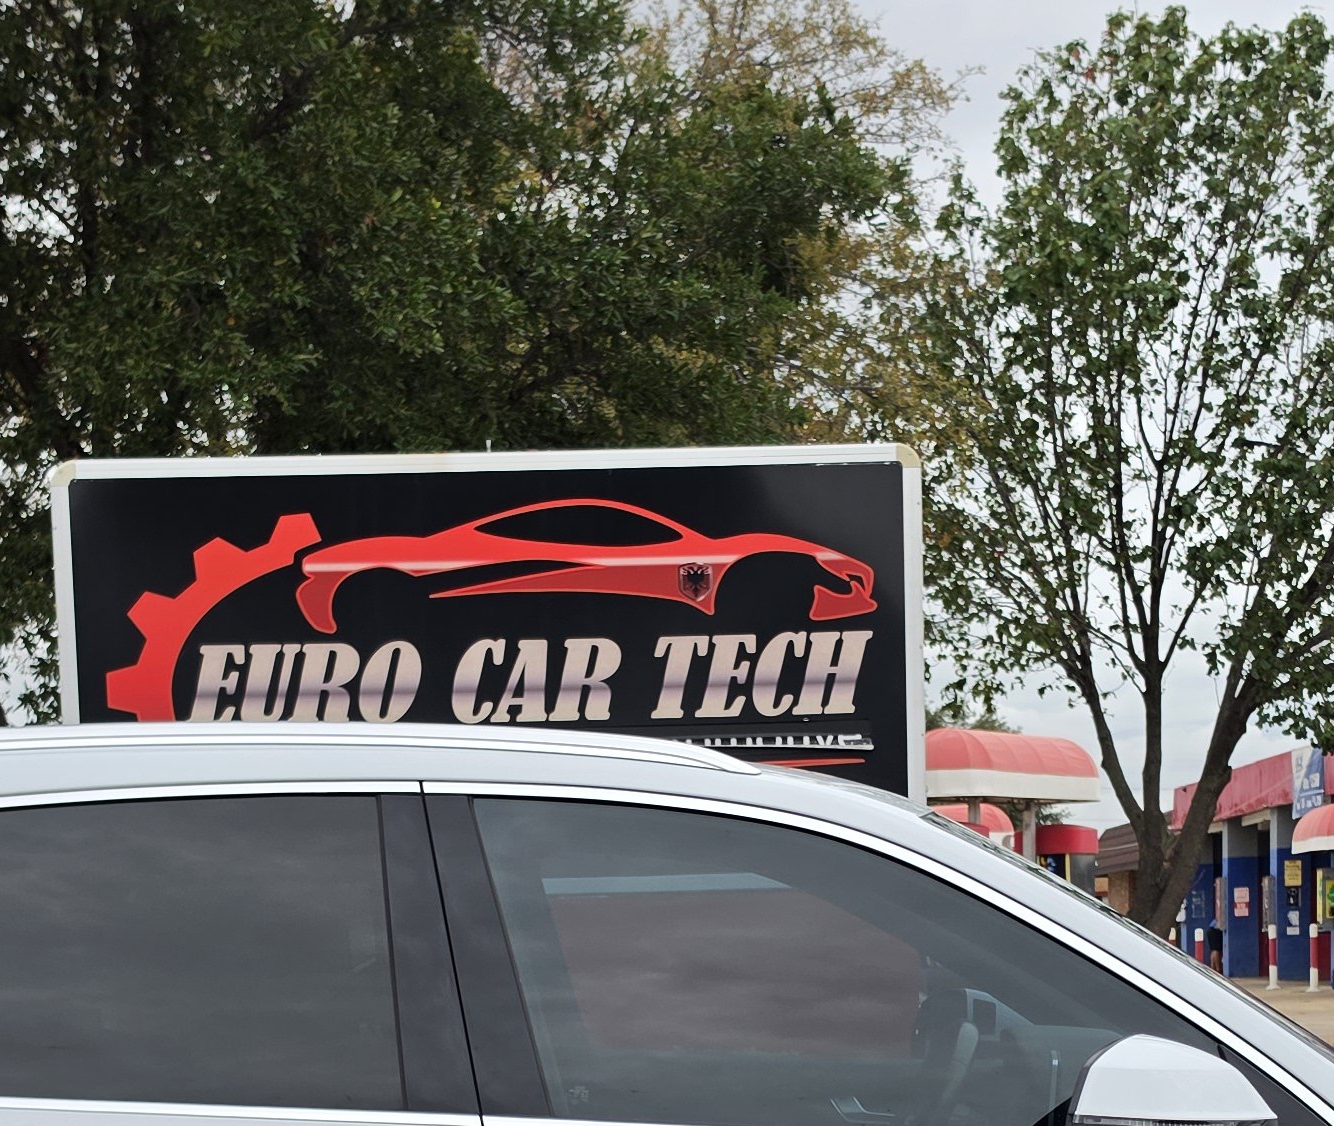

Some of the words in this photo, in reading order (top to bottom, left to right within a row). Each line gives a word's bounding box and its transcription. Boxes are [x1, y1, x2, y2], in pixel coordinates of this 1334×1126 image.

[187, 640, 422, 723] EURO
[451, 637, 622, 724] CAR
[651, 630, 874, 719] TECH
